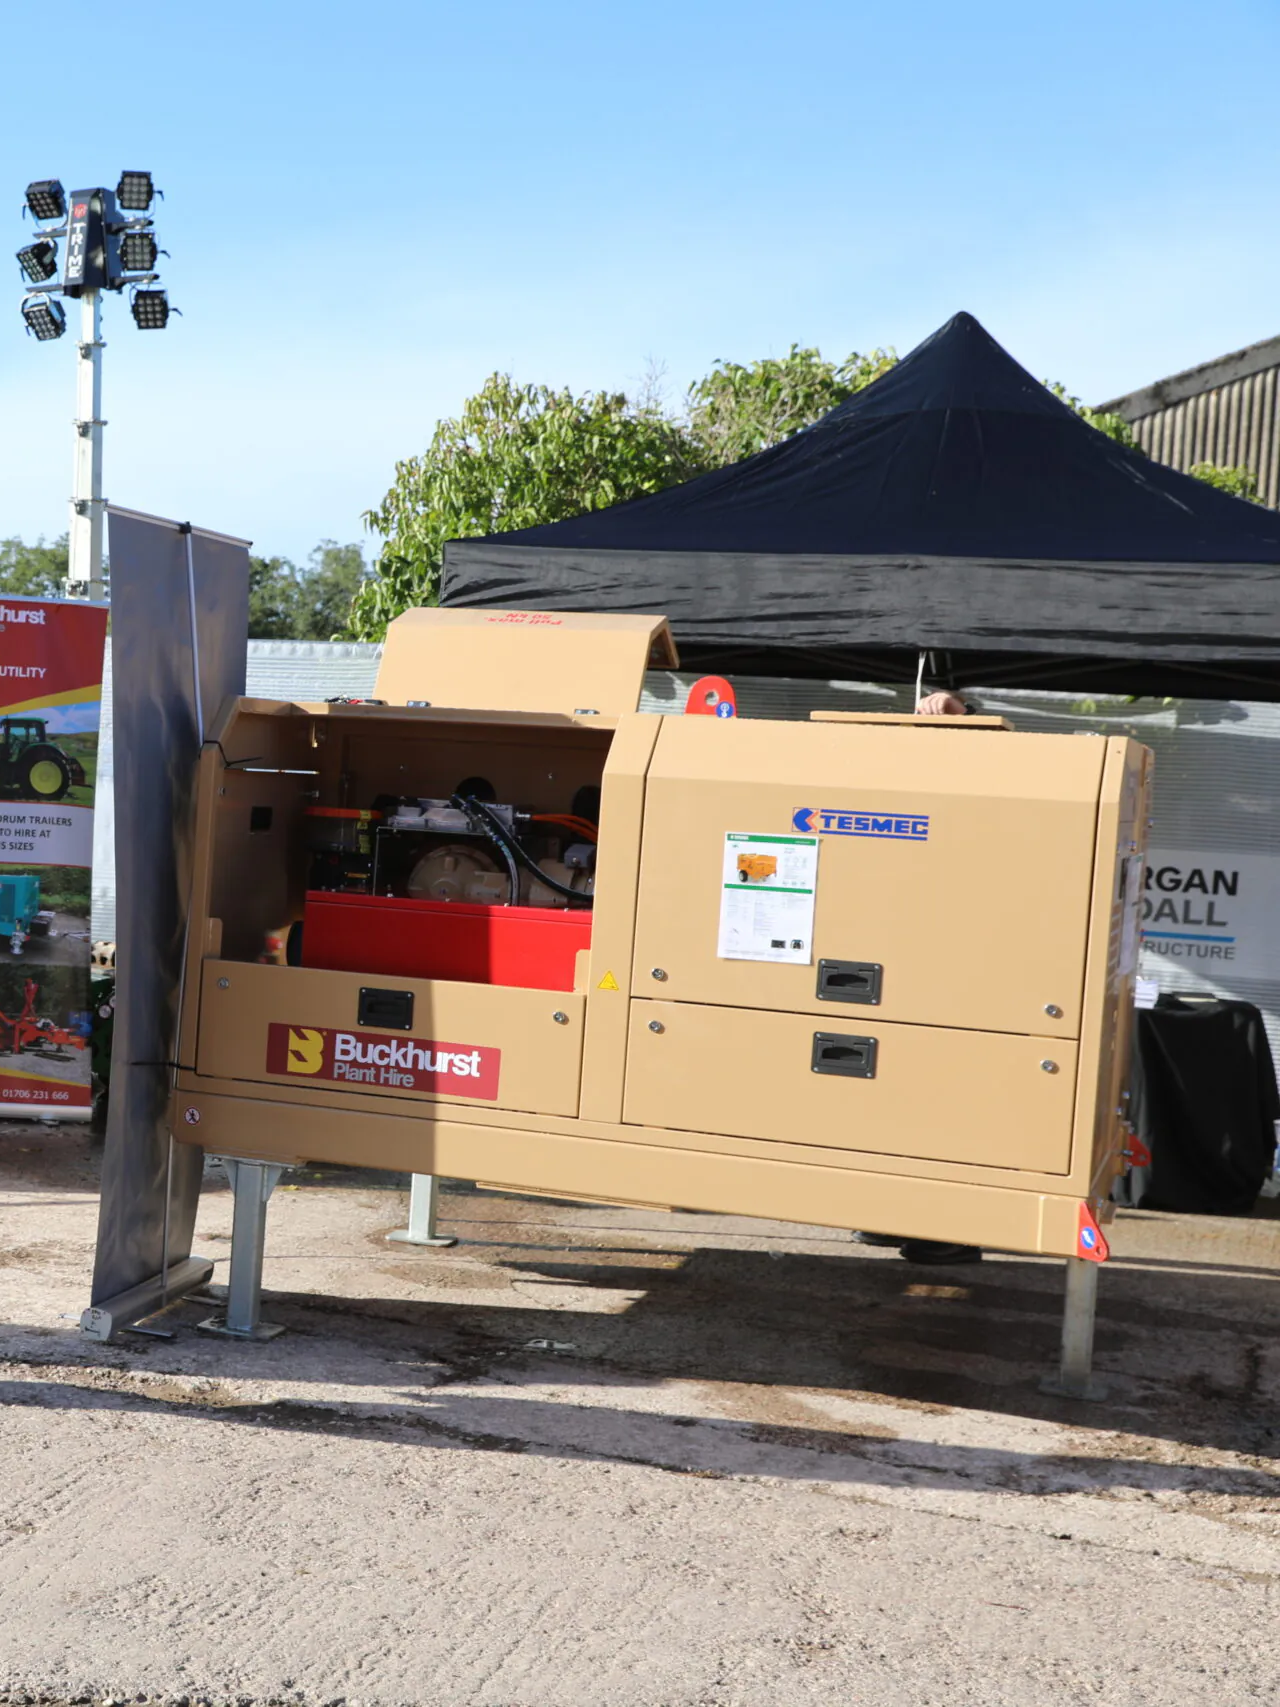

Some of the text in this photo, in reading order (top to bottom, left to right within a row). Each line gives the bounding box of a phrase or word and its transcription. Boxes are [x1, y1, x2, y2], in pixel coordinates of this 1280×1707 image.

[68, 222, 87, 279] TRIME
[29, 815, 73, 827] TRAILERS
[820, 813, 929, 836] TESMEC
[14, 828, 37, 838] HIRE
[39, 829, 52, 839] AT
[8, 841, 35, 851] SIZES
[334, 1033, 481, 1078] Buckhurst
[333, 1062, 415, 1088] Plant Hire
[2, 1088, 30, 1099] 01706
[32, 1090, 49, 1100] 231
[52, 1090, 70, 1101] 666
